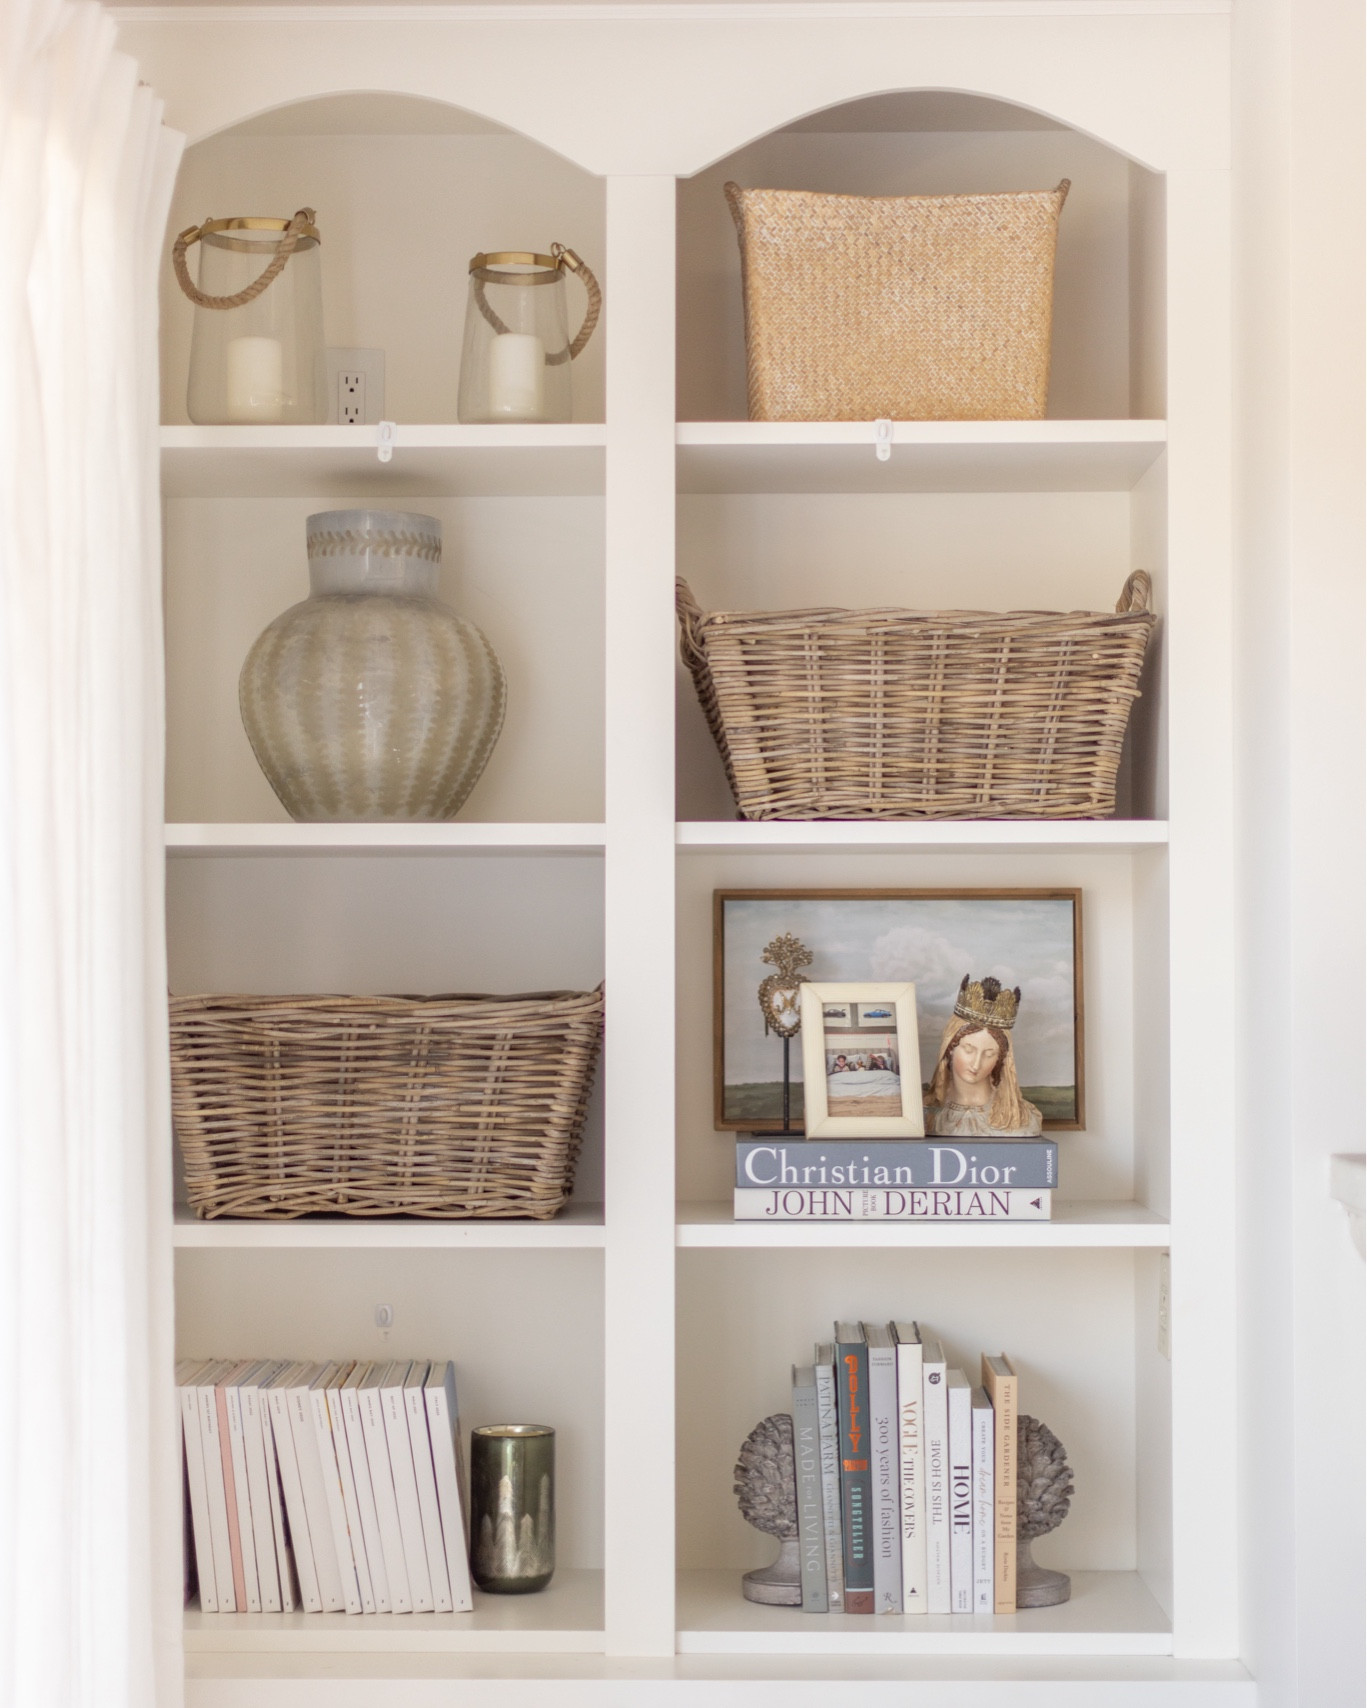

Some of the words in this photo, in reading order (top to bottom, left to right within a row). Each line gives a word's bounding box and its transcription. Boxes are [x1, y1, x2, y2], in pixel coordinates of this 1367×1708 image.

[744, 1147, 912, 1184] Christian
[928, 1147, 1016, 1184] Dior
[765, 1191, 853, 1215] JOHN
[884, 1191, 1011, 1215] DERIAN
[818, 1377, 832, 1430] PATINA
[844, 1354, 861, 1453] DOLLY
[876, 1417, 889, 1444] 300
[903, 1401, 918, 1455] VOGUE
[800, 1427, 815, 1484] MADE
[822, 1435, 835, 1475] FARM
[876, 1448, 890, 1485] years
[903, 1458, 914, 1485] THE
[931, 1440, 941, 1477] HOME
[881, 1489, 893, 1504] of
[932, 1481, 941, 1492] IS
[953, 1466, 970, 1535] HOME
[851, 1487, 864, 1559] SONGTELLER
[904, 1488, 915, 1539] COVERS
[932, 1495, 942, 1525] THIS
[804, 1504, 821, 1571] LIVING
[882, 1507, 895, 1558] fashion
